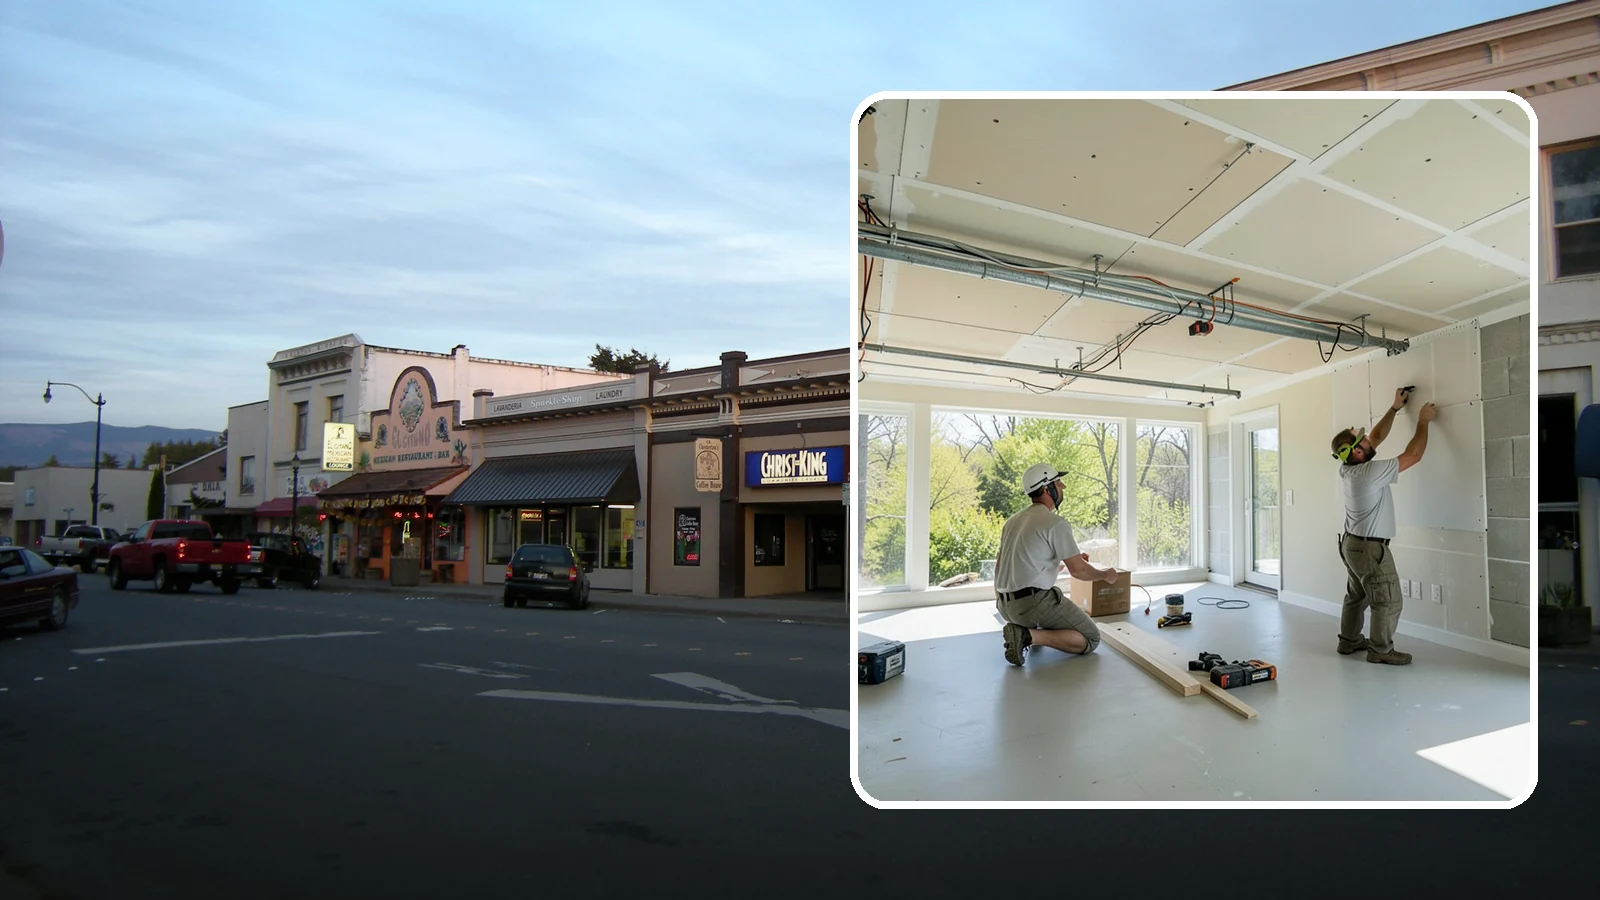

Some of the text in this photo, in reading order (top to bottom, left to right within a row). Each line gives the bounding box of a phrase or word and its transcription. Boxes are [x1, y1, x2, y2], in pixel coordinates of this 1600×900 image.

[596, 389, 623, 400] LAUNDRY
[493, 402, 523, 412] LAVANDERIA
[531, 395, 582, 409] Sparkle Shop
[374, 455, 396, 465] MEXICAN
[397, 452, 433, 462] RESTAURANT
[438, 450, 450, 459] BAR
[760, 450, 828, 478] CHRIST KING
[696, 481, 722, 489] Coffee House
